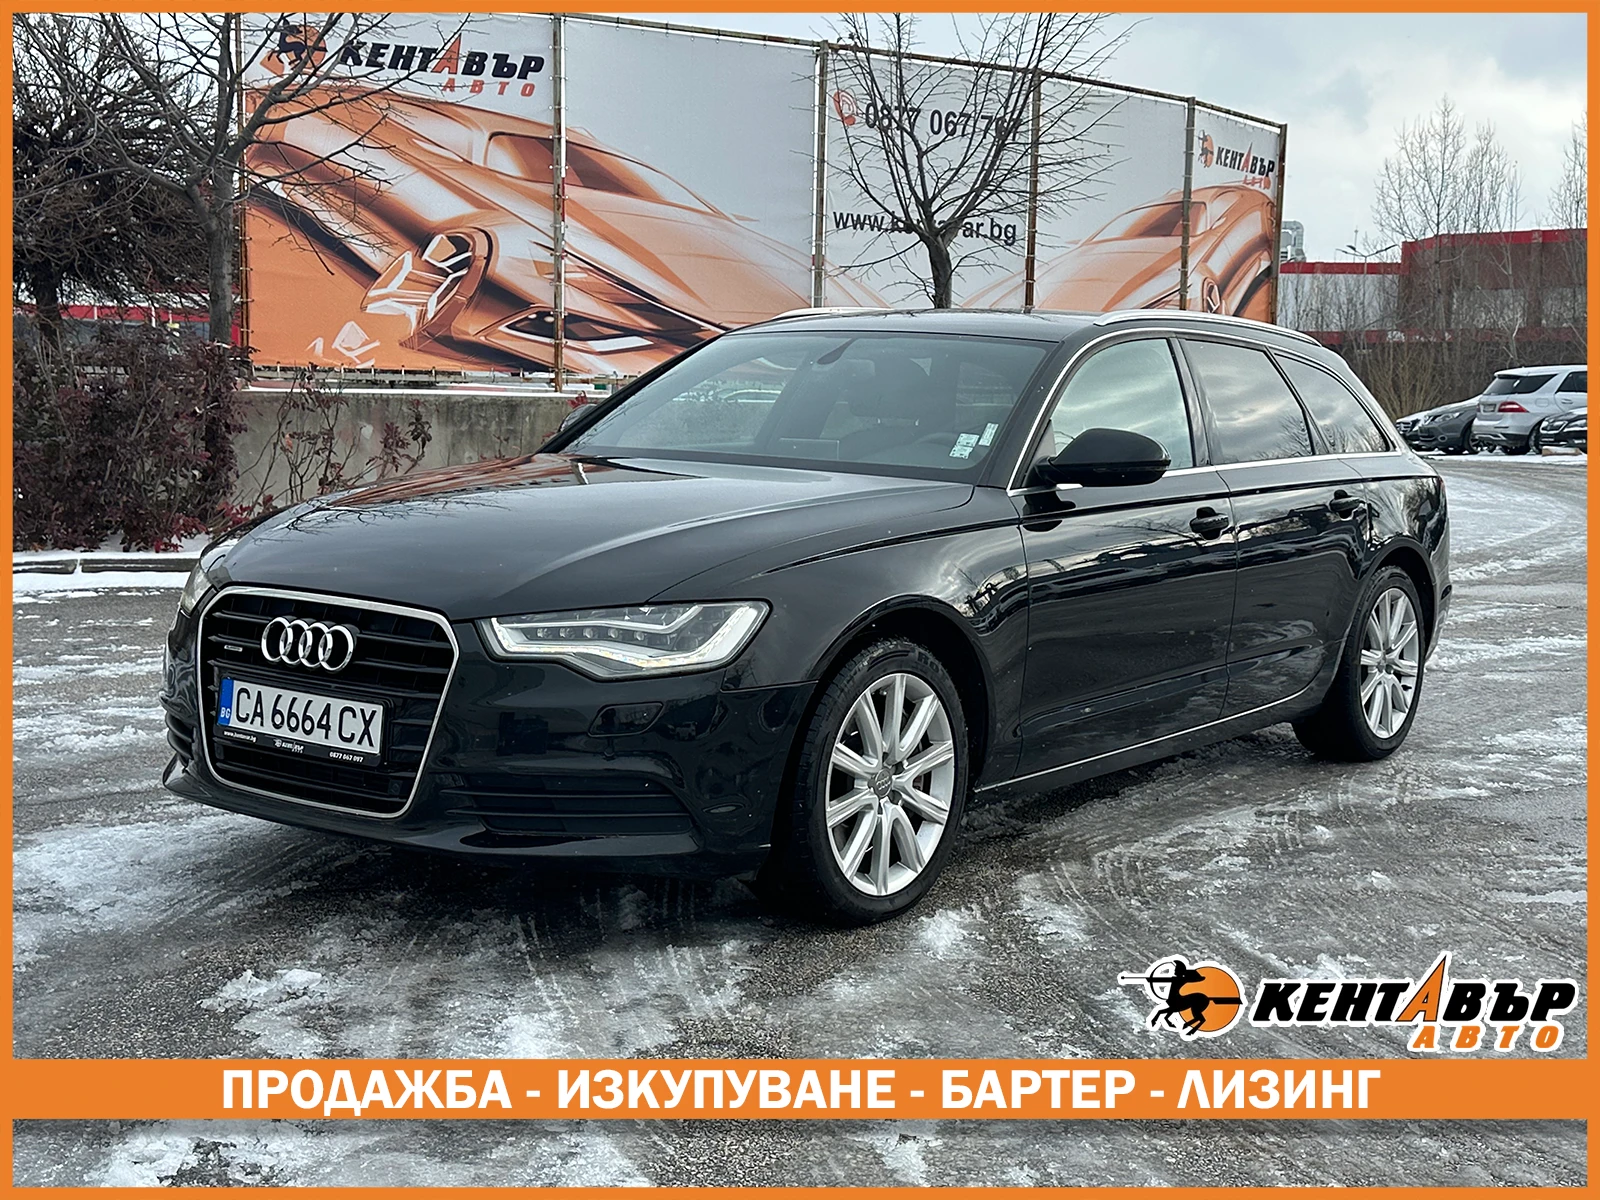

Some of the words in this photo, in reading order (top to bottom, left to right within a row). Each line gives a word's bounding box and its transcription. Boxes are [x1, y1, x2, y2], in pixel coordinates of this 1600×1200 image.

[339, 32, 546, 80] КЕНТАВЪР
[443, 78, 536, 98] АВТО
[930, 109, 970, 138] 067
[1215, 142, 1275, 177] КЕНТАВЪР
[220, 706, 231, 719] BG
[271, 694, 331, 740] 6664
